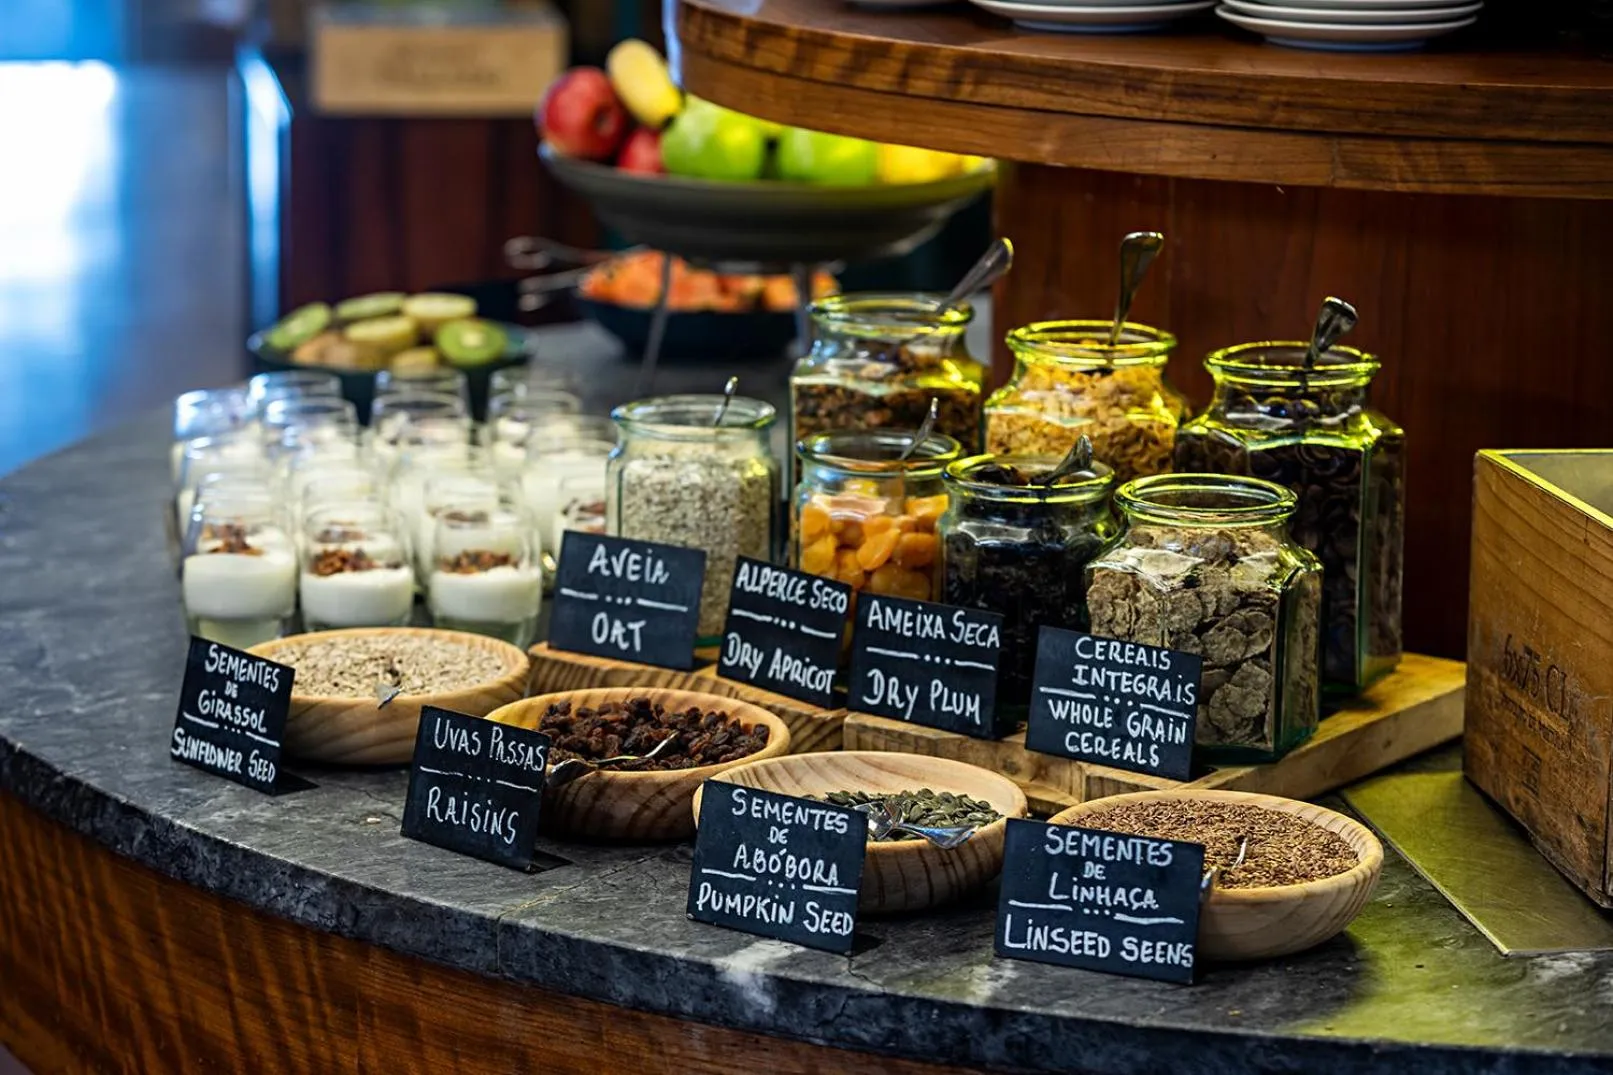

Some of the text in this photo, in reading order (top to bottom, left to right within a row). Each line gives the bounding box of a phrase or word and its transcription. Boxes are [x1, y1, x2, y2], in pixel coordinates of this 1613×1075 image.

[736, 562, 847, 613] ALPERCE SECO
[591, 611, 646, 652] OAT
[950, 610, 1000, 648] SECA
[205, 644, 280, 693] SEMENTES
[722, 632, 764, 679] DRY
[224, 680, 238, 698] DE
[862, 668, 981, 725] DRY PLUM
[1048, 699, 1113, 728] WHOLE
[434, 718, 545, 771] UVAS PASSAS
[1065, 731, 1160, 768] CEREALS
[248, 749, 276, 783] SEED
[731, 788, 849, 834] SEMENTES
[768, 826, 789, 844] DE
[1044, 826, 1173, 866] SEMENTES
[1083, 861, 1106, 880] DE
[803, 901, 854, 936] SEED
